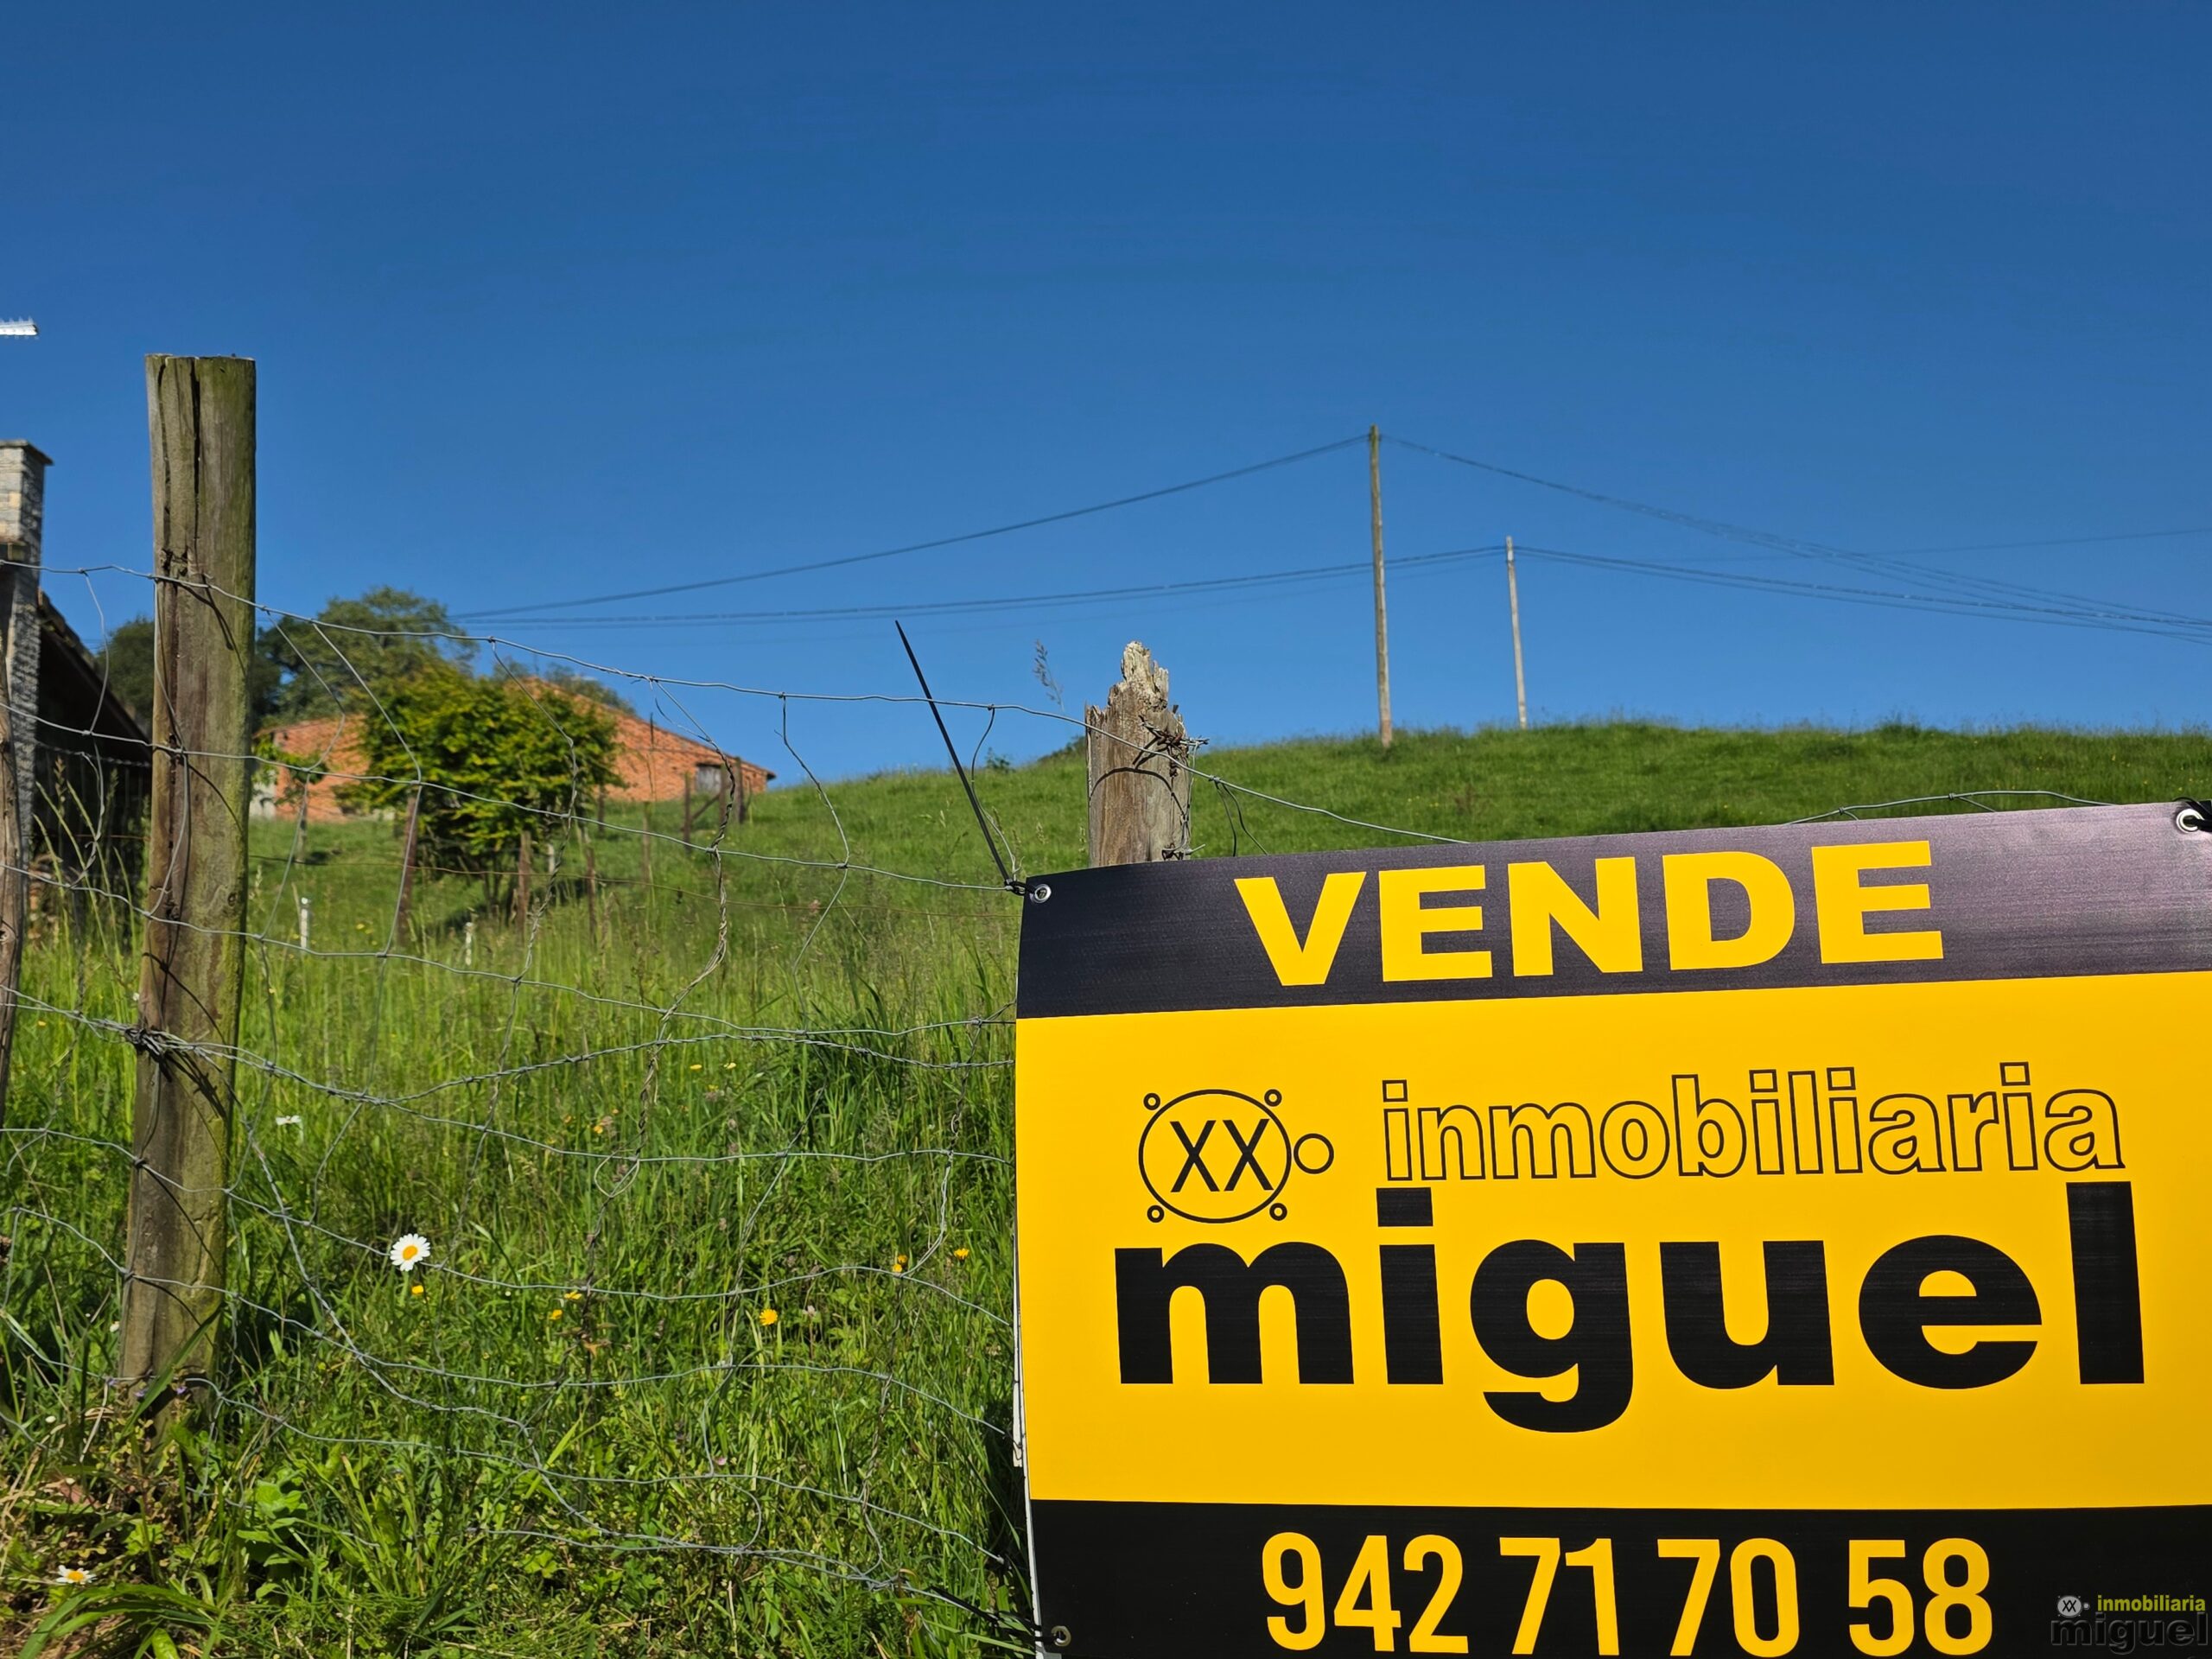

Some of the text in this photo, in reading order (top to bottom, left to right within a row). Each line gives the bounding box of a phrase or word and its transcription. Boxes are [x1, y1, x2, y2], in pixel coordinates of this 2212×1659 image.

[1235, 840, 1944, 986] VENDE
[1383, 1062, 2125, 1180] inmobiliaria
[1116, 1181, 2145, 1433] miguel
[1262, 1532, 1993, 1657] 942 71 70 58
